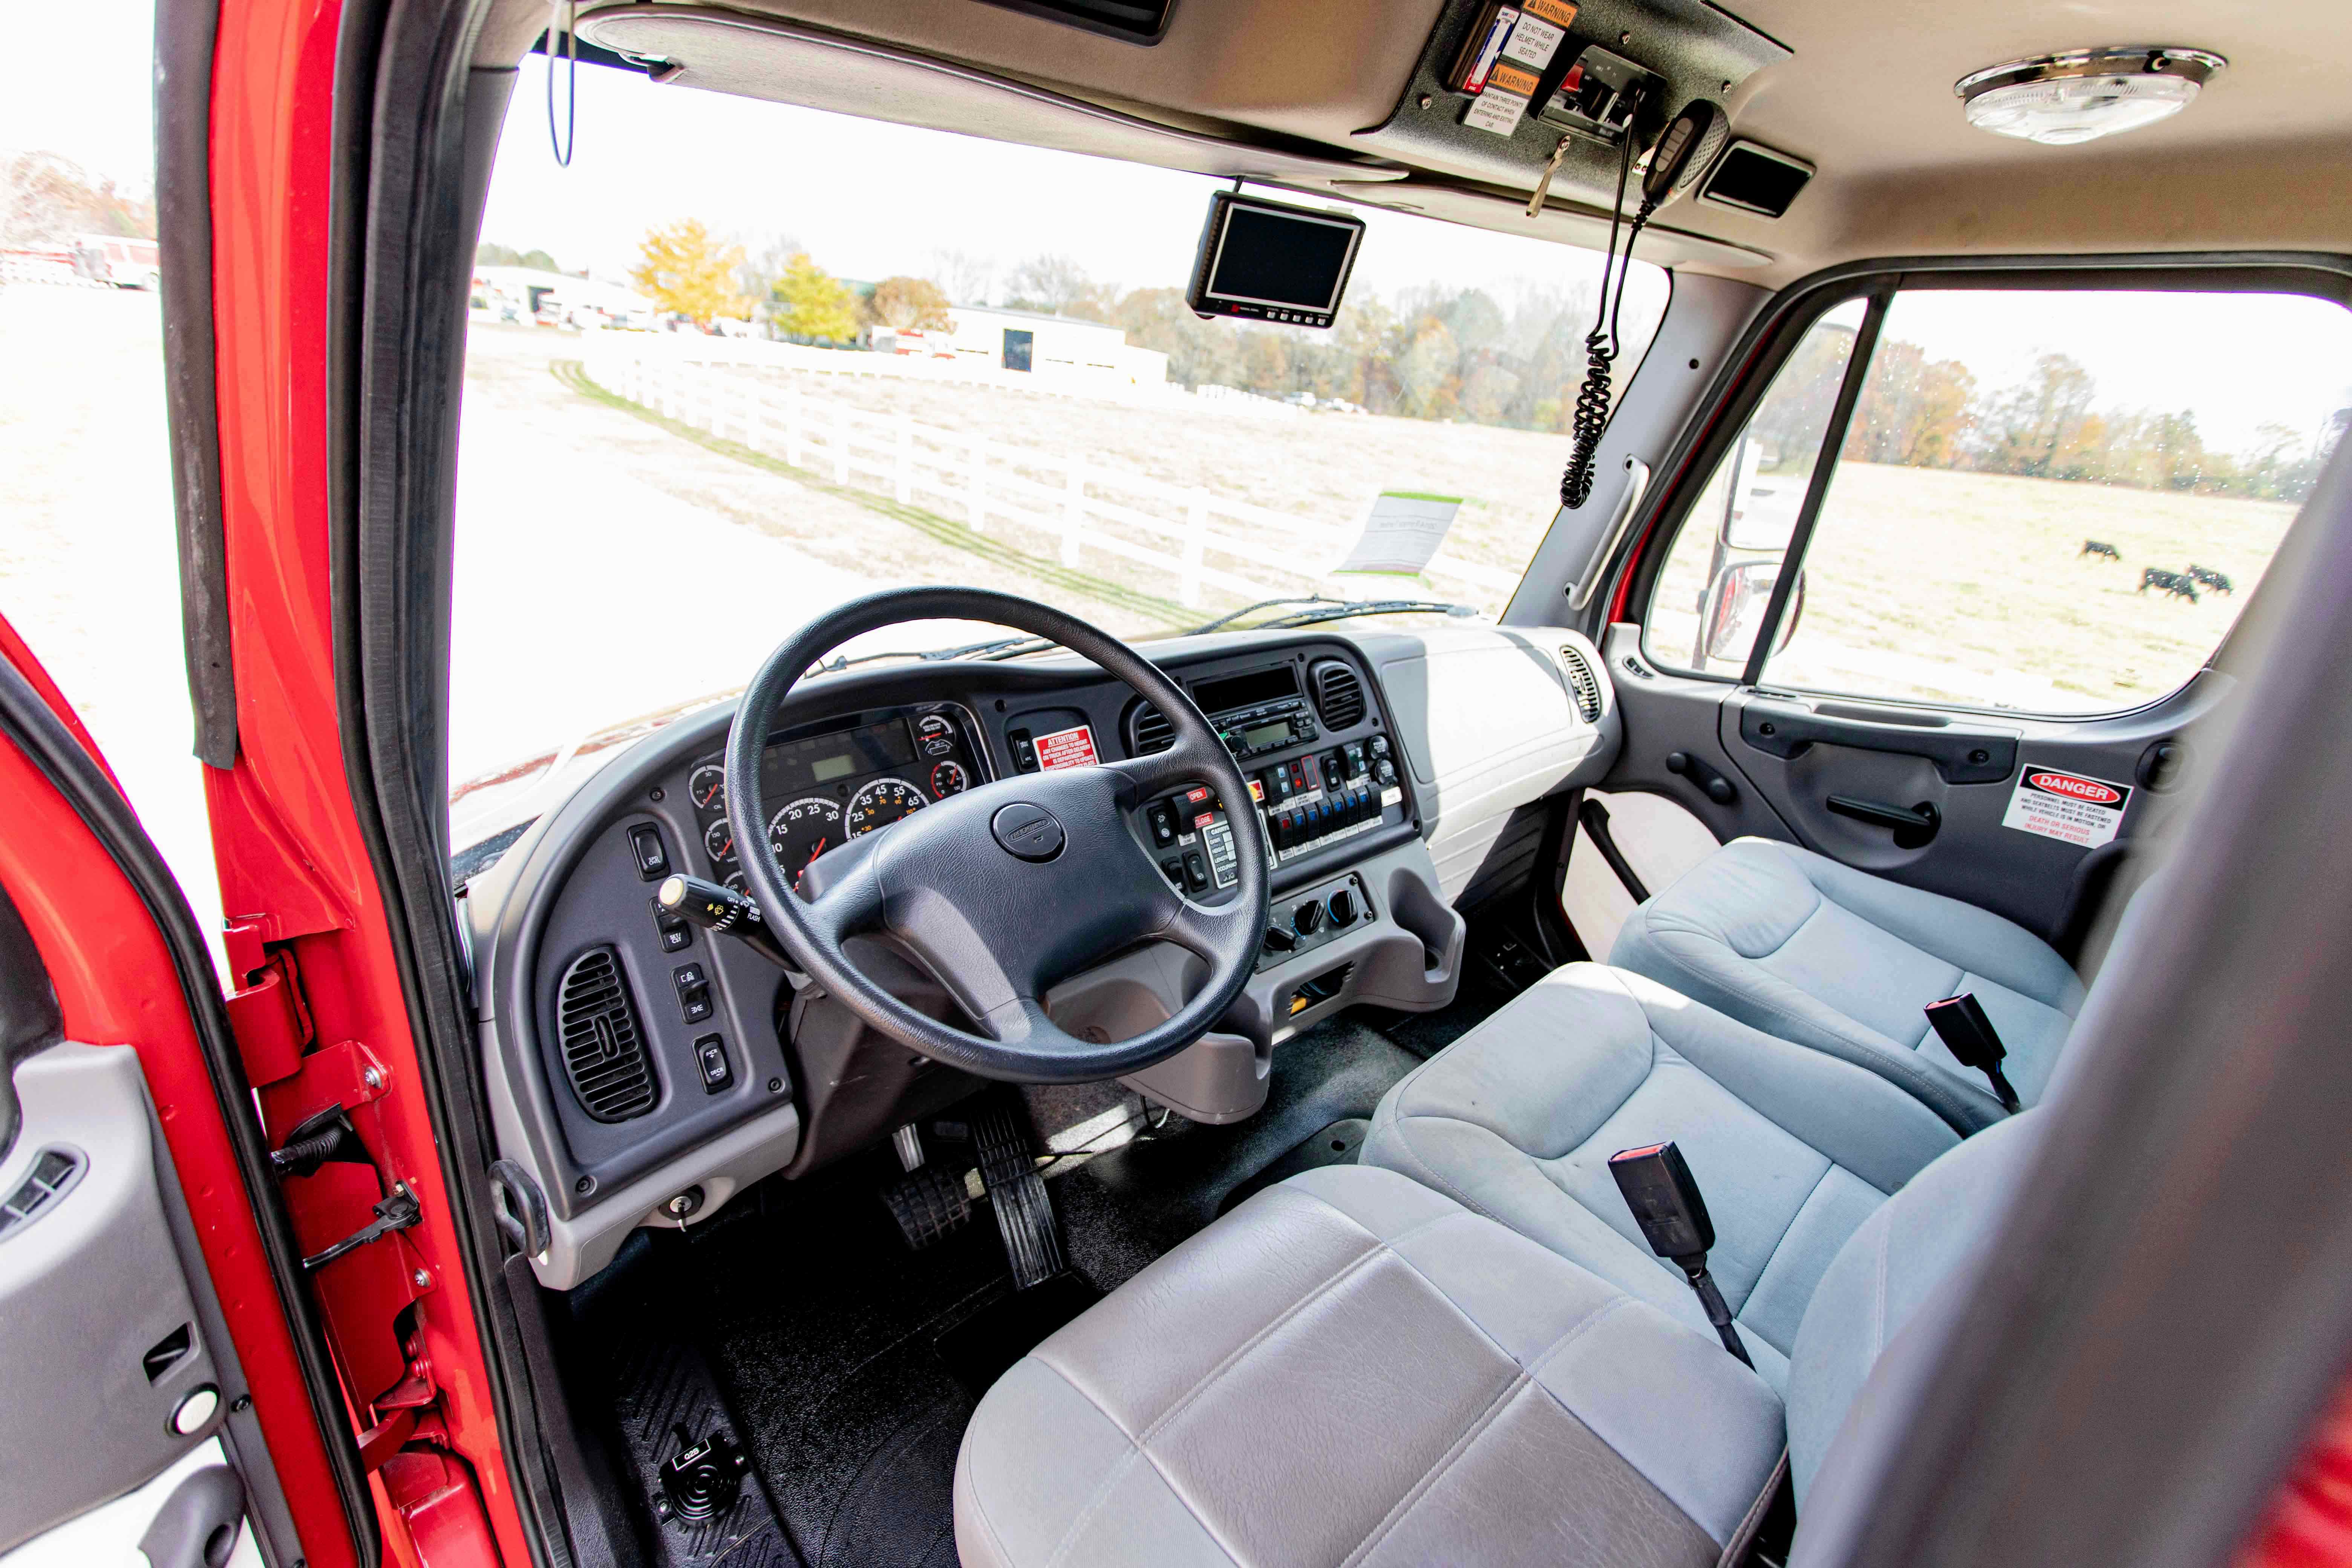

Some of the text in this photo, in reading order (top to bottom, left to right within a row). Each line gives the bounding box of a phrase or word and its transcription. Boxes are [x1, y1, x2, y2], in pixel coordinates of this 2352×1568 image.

[1537, 0, 1571, 23] WARNING
[1531, 26, 1540, 34] NOT
[1540, 30, 1554, 41] WEAR
[1515, 33, 1549, 51] HELMET WHILE
[1518, 47, 1536, 59] SEATED
[1500, 72, 1533, 91] WARNING
[1487, 103, 1504, 112] CONTACT
[1474, 108, 1493, 118] ENTERING
[1499, 116, 1514, 124] EXITING
[1048, 732, 1078, 746] ATTENTION
[875, 785, 887, 795] 45
[894, 786, 905, 796] 55
[2040, 775, 2109, 800] DANGER
[860, 795, 872, 805] 35
[908, 796, 919, 806] 65
[1190, 792, 1203, 800] OPEN
[807, 804, 821, 815] 25
[2030, 793, 2060, 805] PERSONNEL
[2062, 800, 2076, 809] MUST
[2086, 805, 2106, 815] SEATED
[789, 809, 802, 820] 20
[825, 811, 839, 821] 30
[852, 812, 864, 822] 25
[2032, 799, 2060, 812] SEATBELTS
[2084, 812, 2111, 824] FASTENED
[1195, 816, 1211, 825] CLOSE
[2038, 808, 2059, 818] VEHICLE
[2074, 817, 2096, 827] MOTION,
[776, 824, 788, 835] 15
[2029, 815, 2049, 824] DEATH
[2062, 822, 2090, 835] SERIOUS
[2025, 823, 2089, 844] INJURY MAY RESULT
[772, 843, 782, 853] 10
[1214, 854, 1228, 863] LENGTH
[1217, 862, 1237, 873] OCCUPANC
[747, 913, 761, 922] FLASH
[710, 1067, 724, 1076] DECR
[684, 1447, 700, 1460] Q2B
